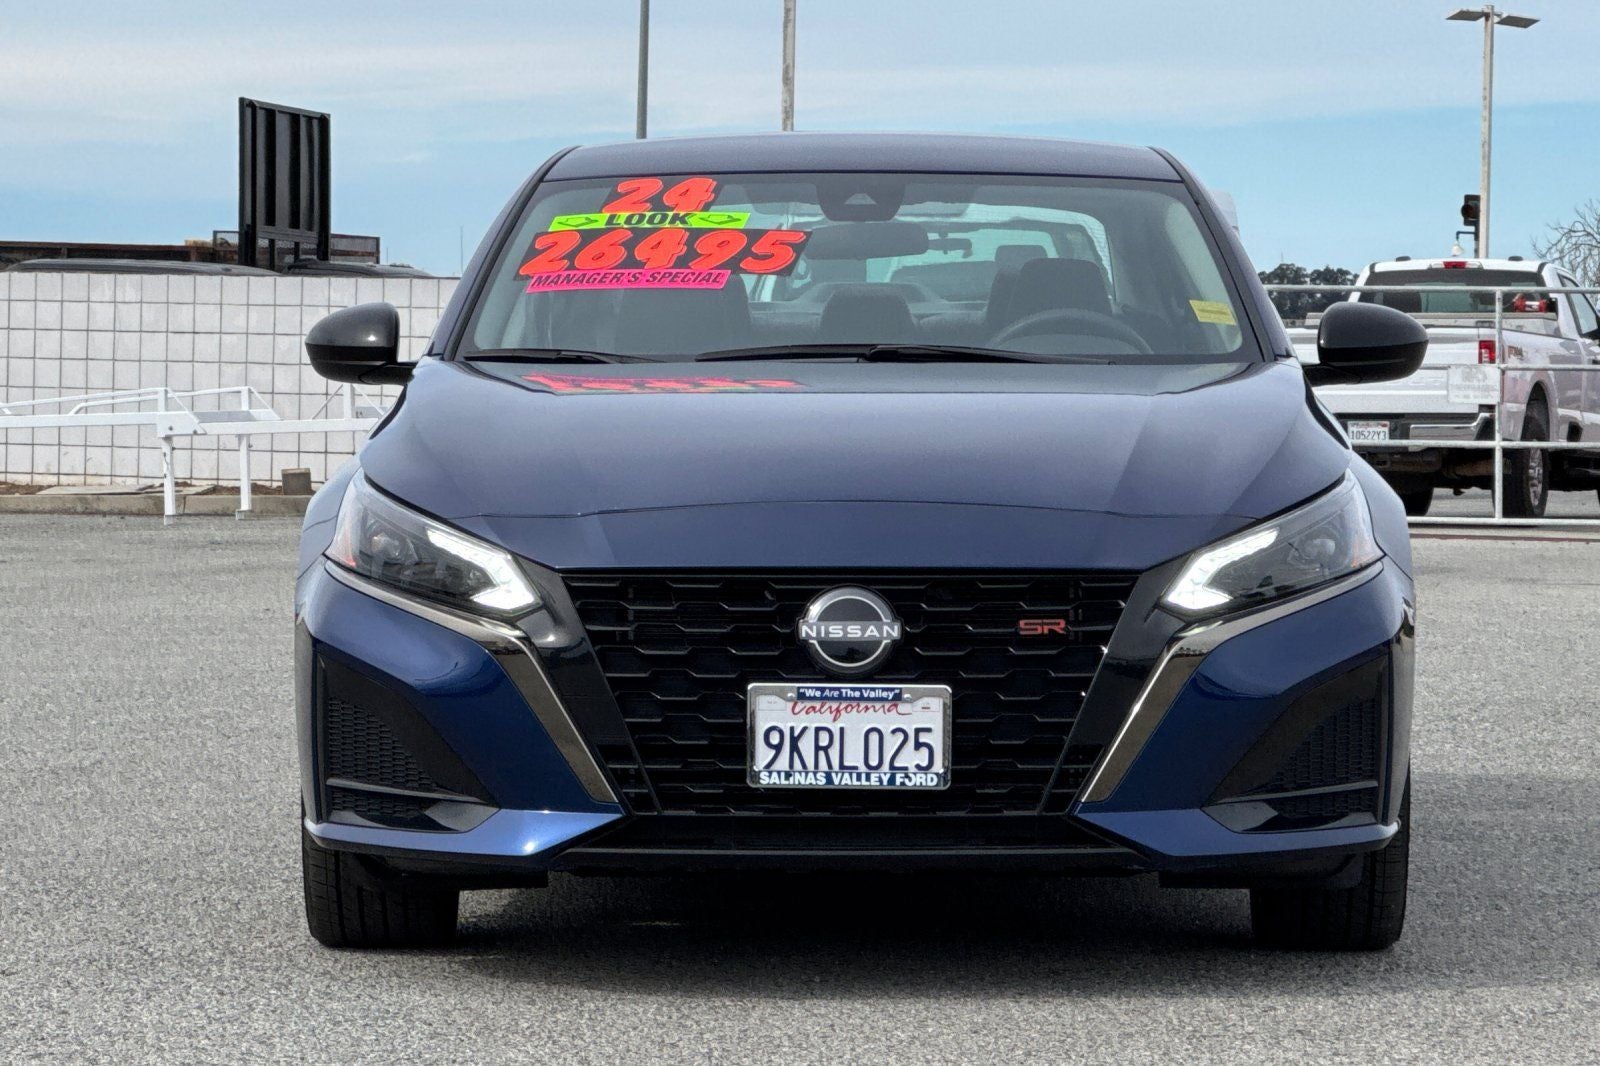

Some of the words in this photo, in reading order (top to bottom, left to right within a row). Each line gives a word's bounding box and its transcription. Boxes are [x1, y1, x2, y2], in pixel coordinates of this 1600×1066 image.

[602, 177, 717, 213] 24
[604, 212, 697, 227] LOOK
[519, 228, 806, 276] 26495
[532, 271, 644, 287] MANAGER'S
[645, 270, 723, 284] SPECIAL
[801, 624, 899, 638] NISSAN
[1018, 618, 1066, 635] SR
[822, 688, 840, 698] Are
[841, 688, 861, 698] The
[791, 701, 913, 723] California
[763, 724, 935, 772] 9KRL025
[759, 771, 827, 785] SALINAS
[831, 772, 891, 786] VALLEY
[894, 772, 938, 787] FORD
